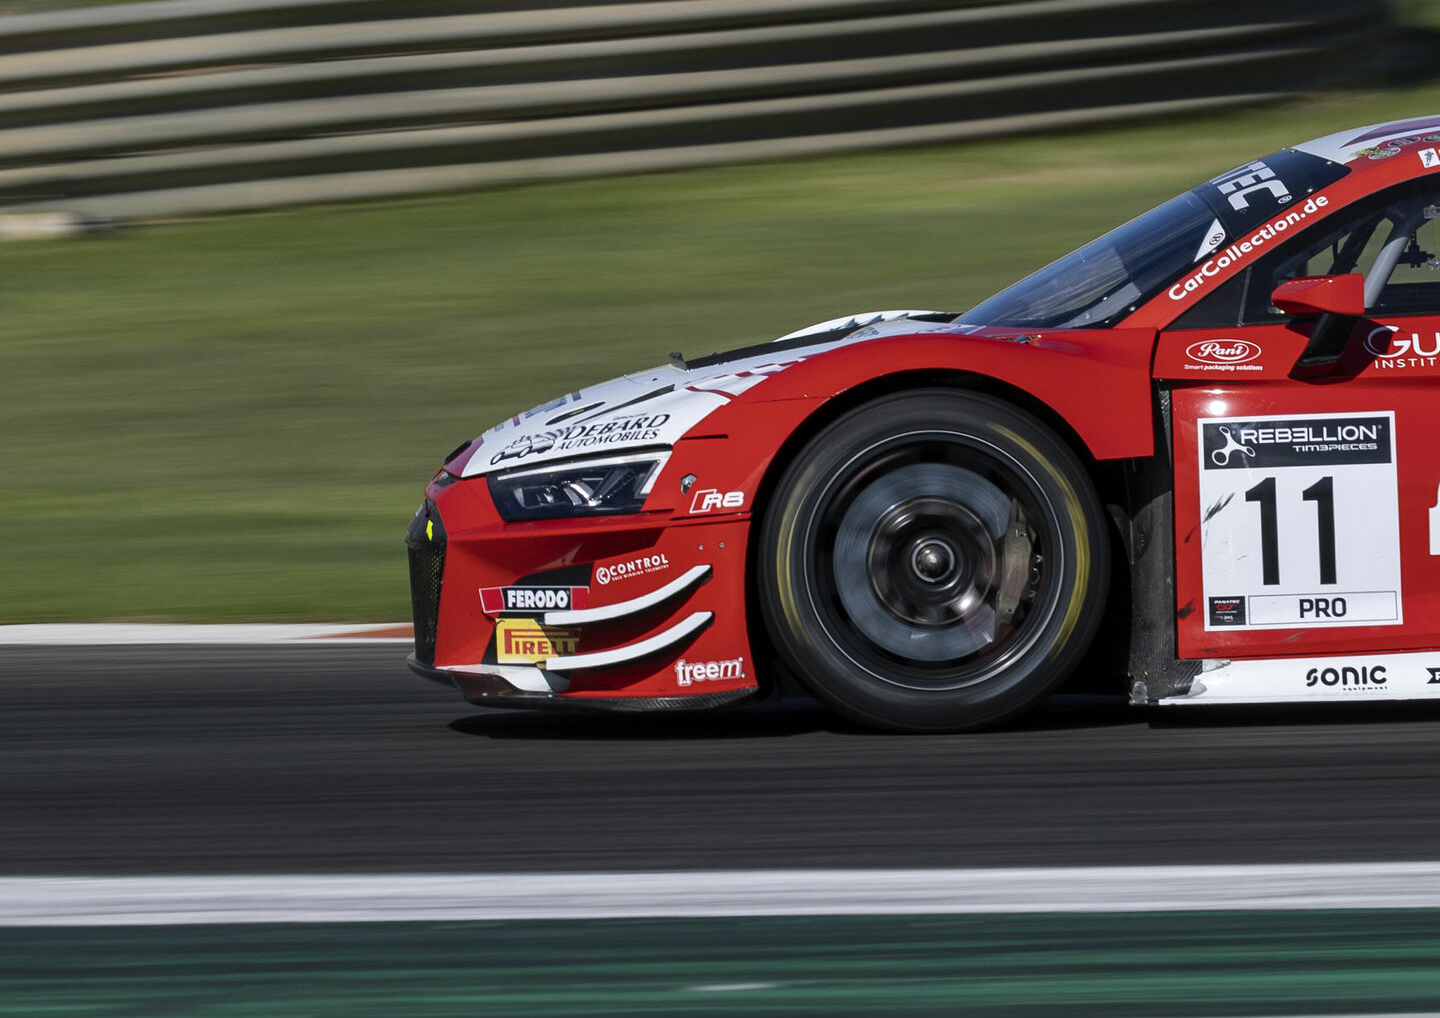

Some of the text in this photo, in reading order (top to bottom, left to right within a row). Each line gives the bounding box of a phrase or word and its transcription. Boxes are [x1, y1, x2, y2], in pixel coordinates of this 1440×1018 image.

[1168, 195, 1329, 300] CarCollection.de
[563, 414, 671, 440] DEBARD
[553, 428, 660, 451] AUTOMOBILES
[1244, 475, 1338, 586] 11
[609, 553, 669, 576] CONTROL
[507, 589, 569, 609] FERODO
[1299, 597, 1347, 619] PRO
